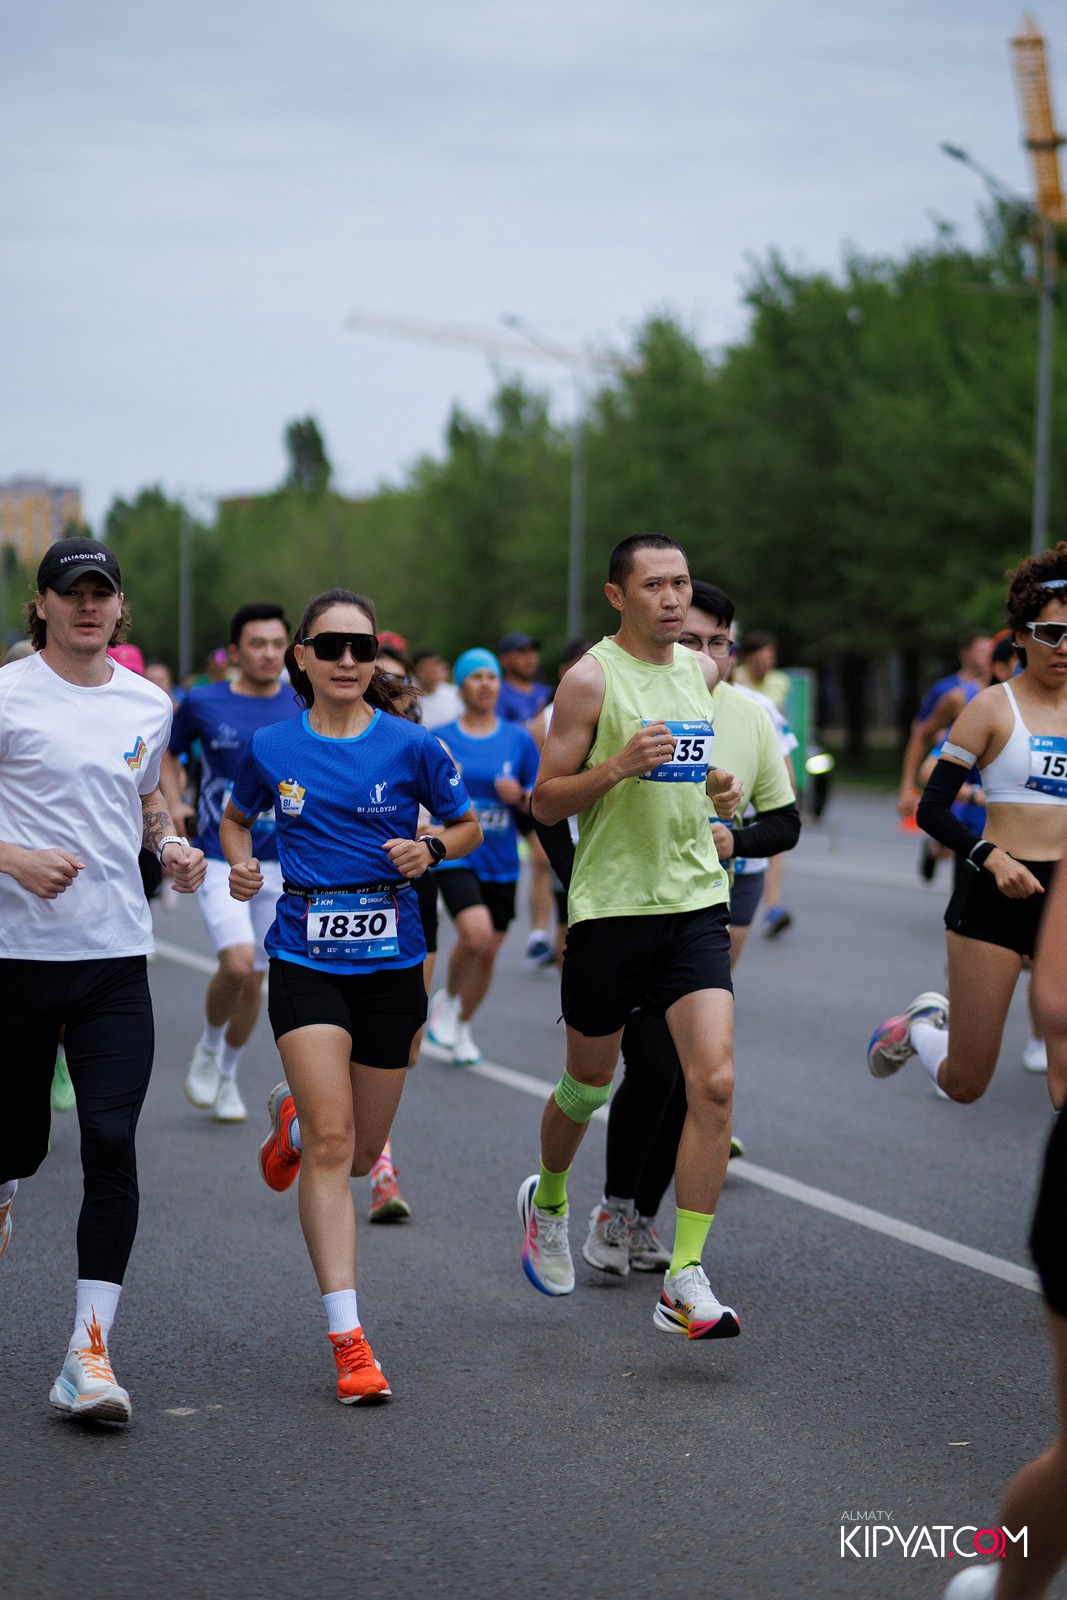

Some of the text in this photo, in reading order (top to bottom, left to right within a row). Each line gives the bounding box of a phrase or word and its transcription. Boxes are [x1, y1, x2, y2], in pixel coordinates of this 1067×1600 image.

[1042, 755, 1067, 778] 15
[283, 798, 291, 807] BI
[318, 912, 387, 938] 1830
